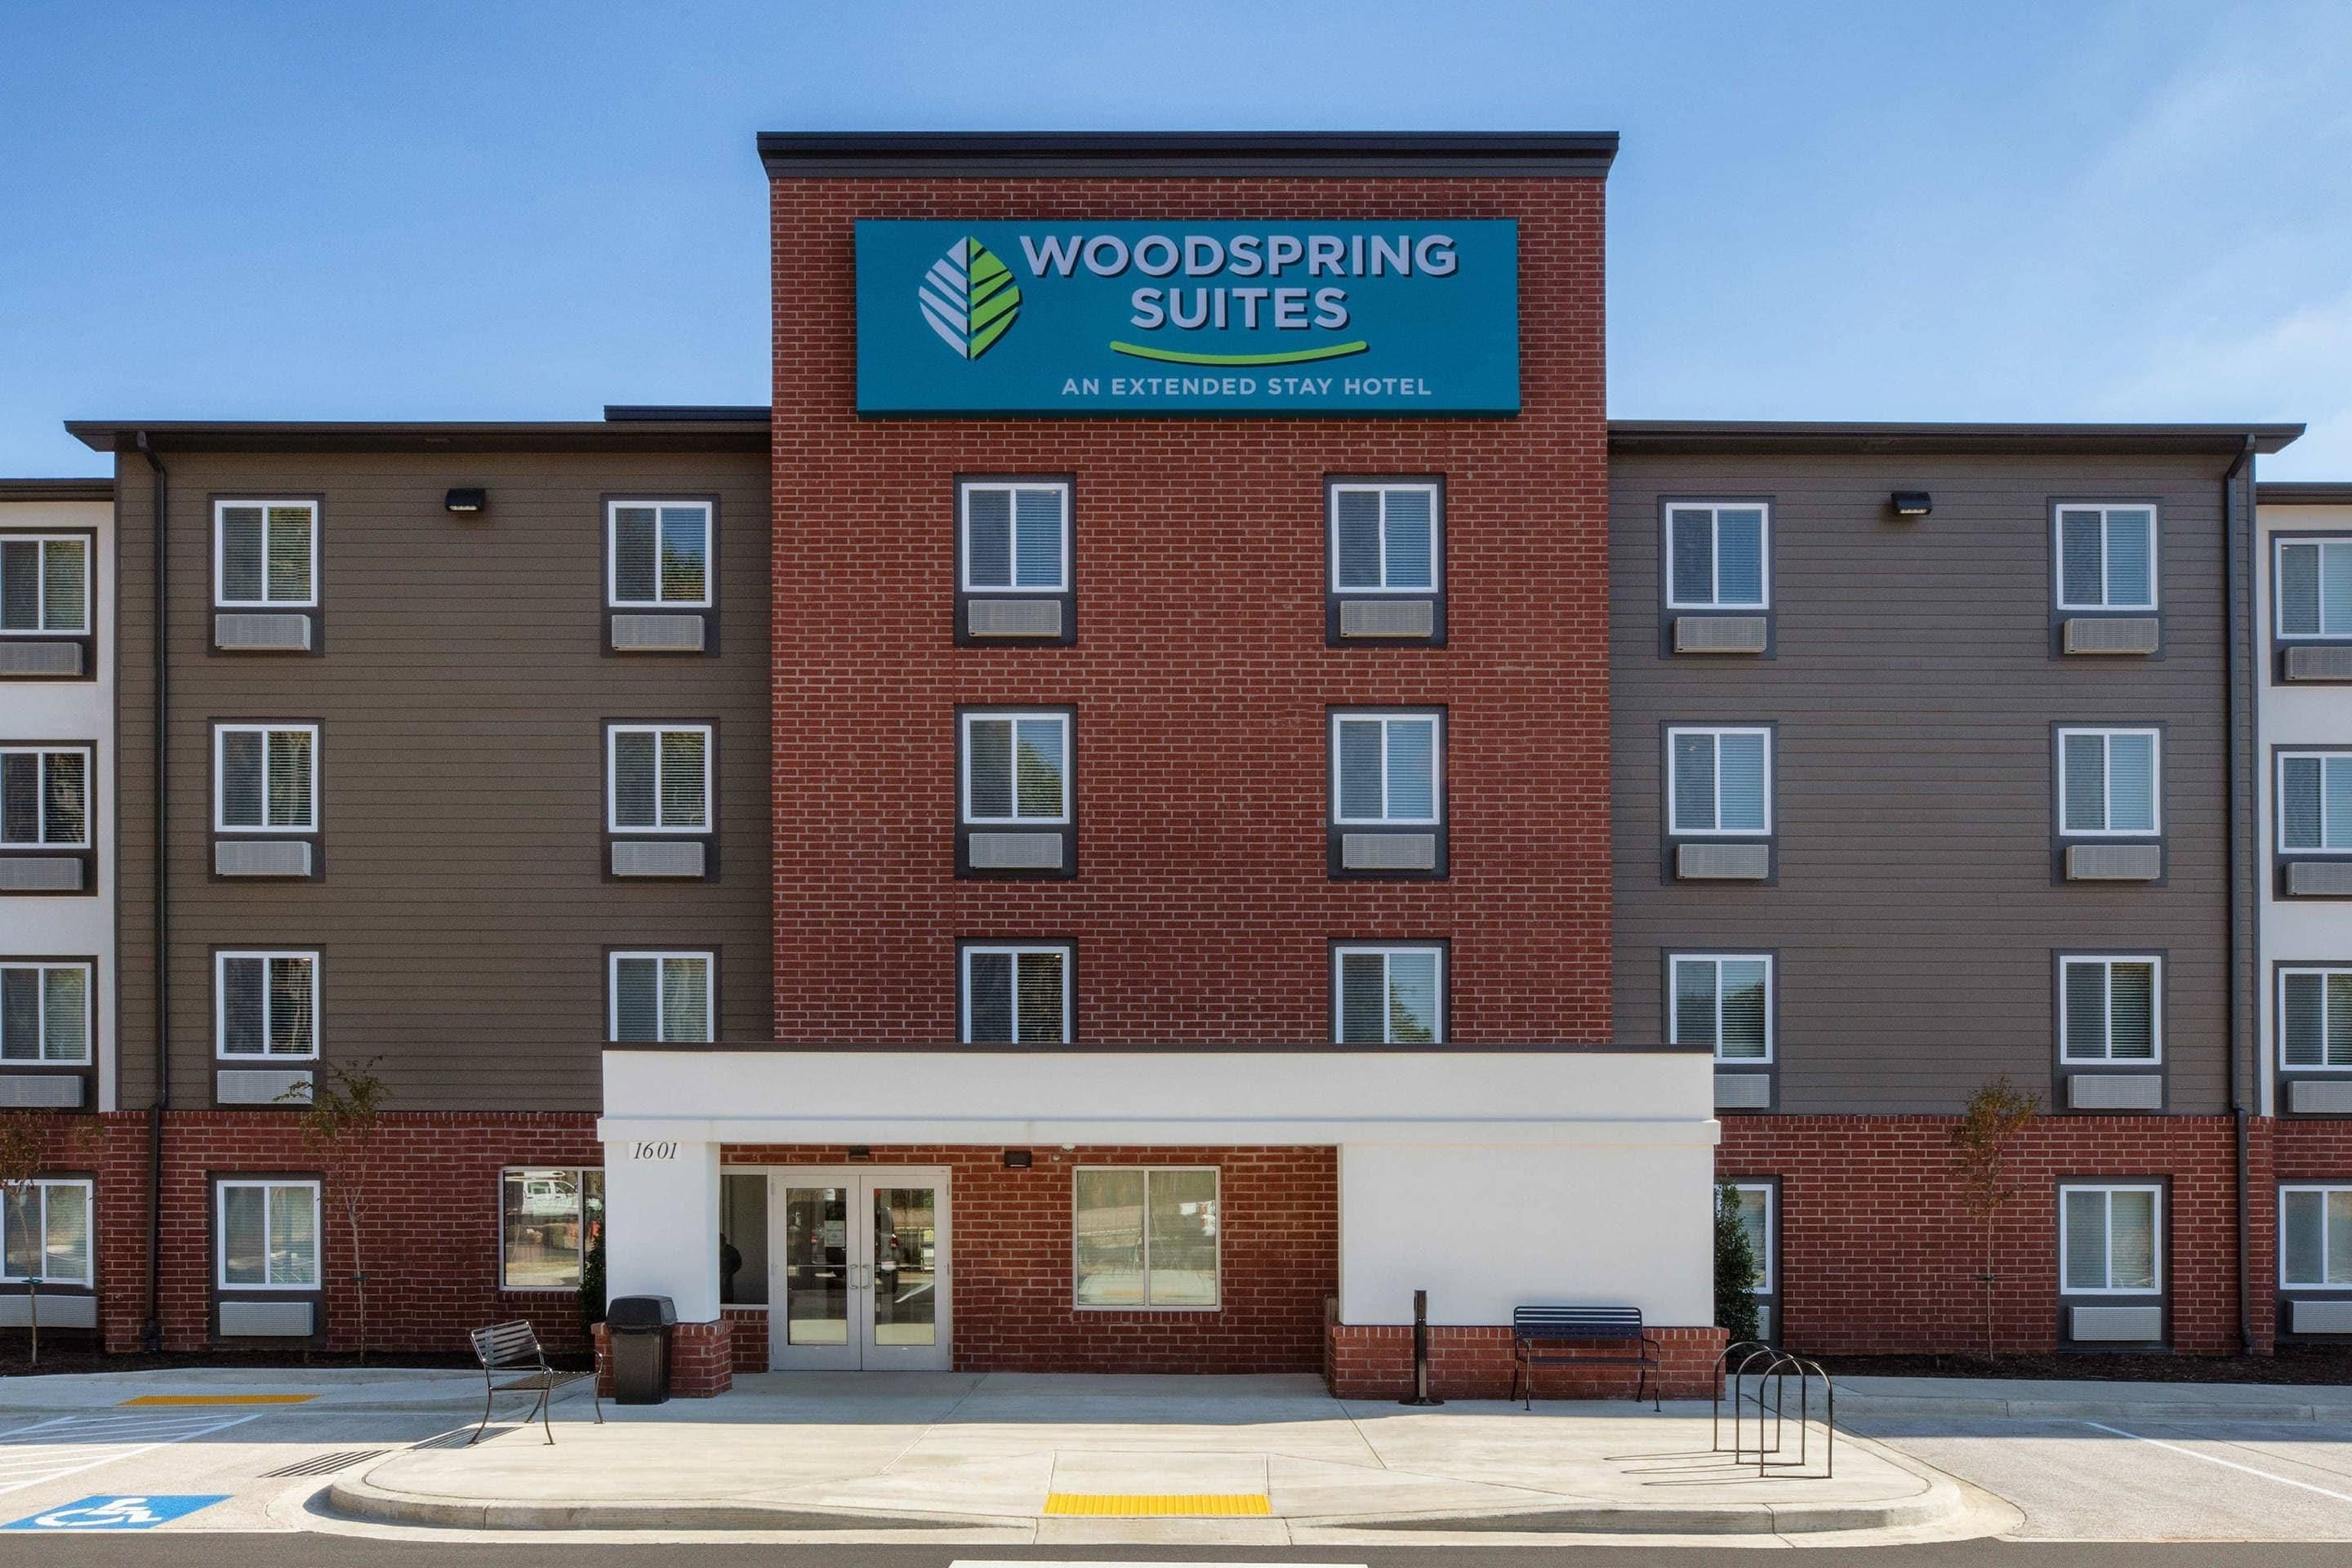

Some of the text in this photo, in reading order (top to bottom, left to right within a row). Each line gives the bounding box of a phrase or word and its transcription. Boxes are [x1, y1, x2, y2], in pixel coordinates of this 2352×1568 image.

[1019, 234, 1457, 277] WOODSPRING
[1130, 286, 1348, 329] SUITES
[1062, 377, 1432, 396] AN EXTENDED STAY HOTEL
[633, 1142, 678, 1160] 1601
